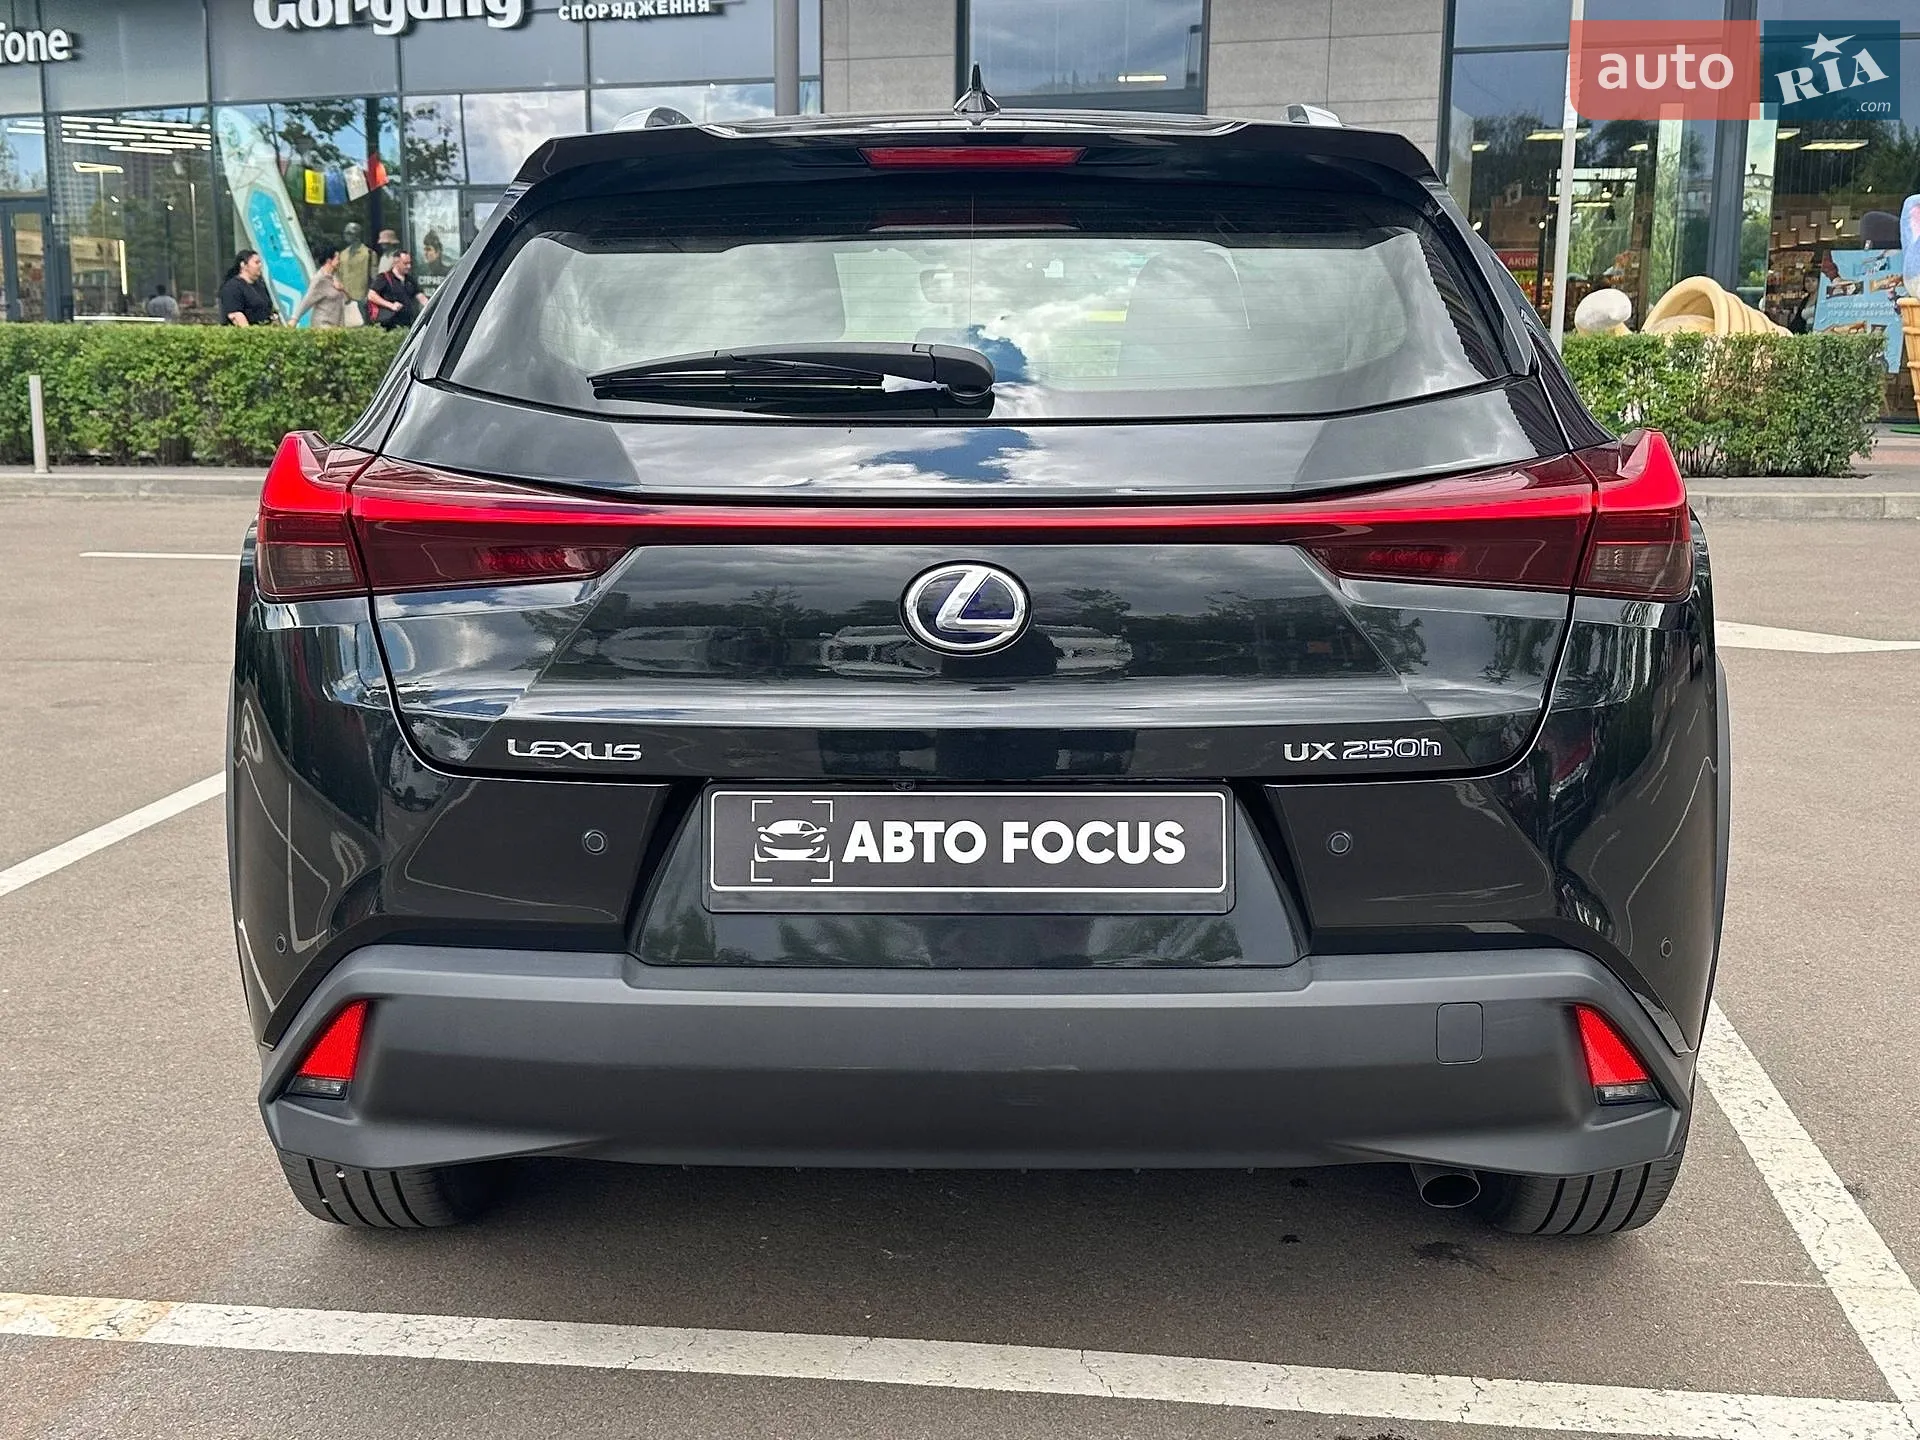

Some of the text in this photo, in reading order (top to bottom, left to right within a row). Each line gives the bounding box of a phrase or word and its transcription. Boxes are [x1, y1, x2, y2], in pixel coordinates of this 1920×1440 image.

[558, 0, 710, 20] СПОРЯДЖЕННЯ
[507, 738, 643, 761] LEXUS
[1283, 737, 1442, 762] UX 250h
[842, 820, 1186, 865] АВТО FOCUS
